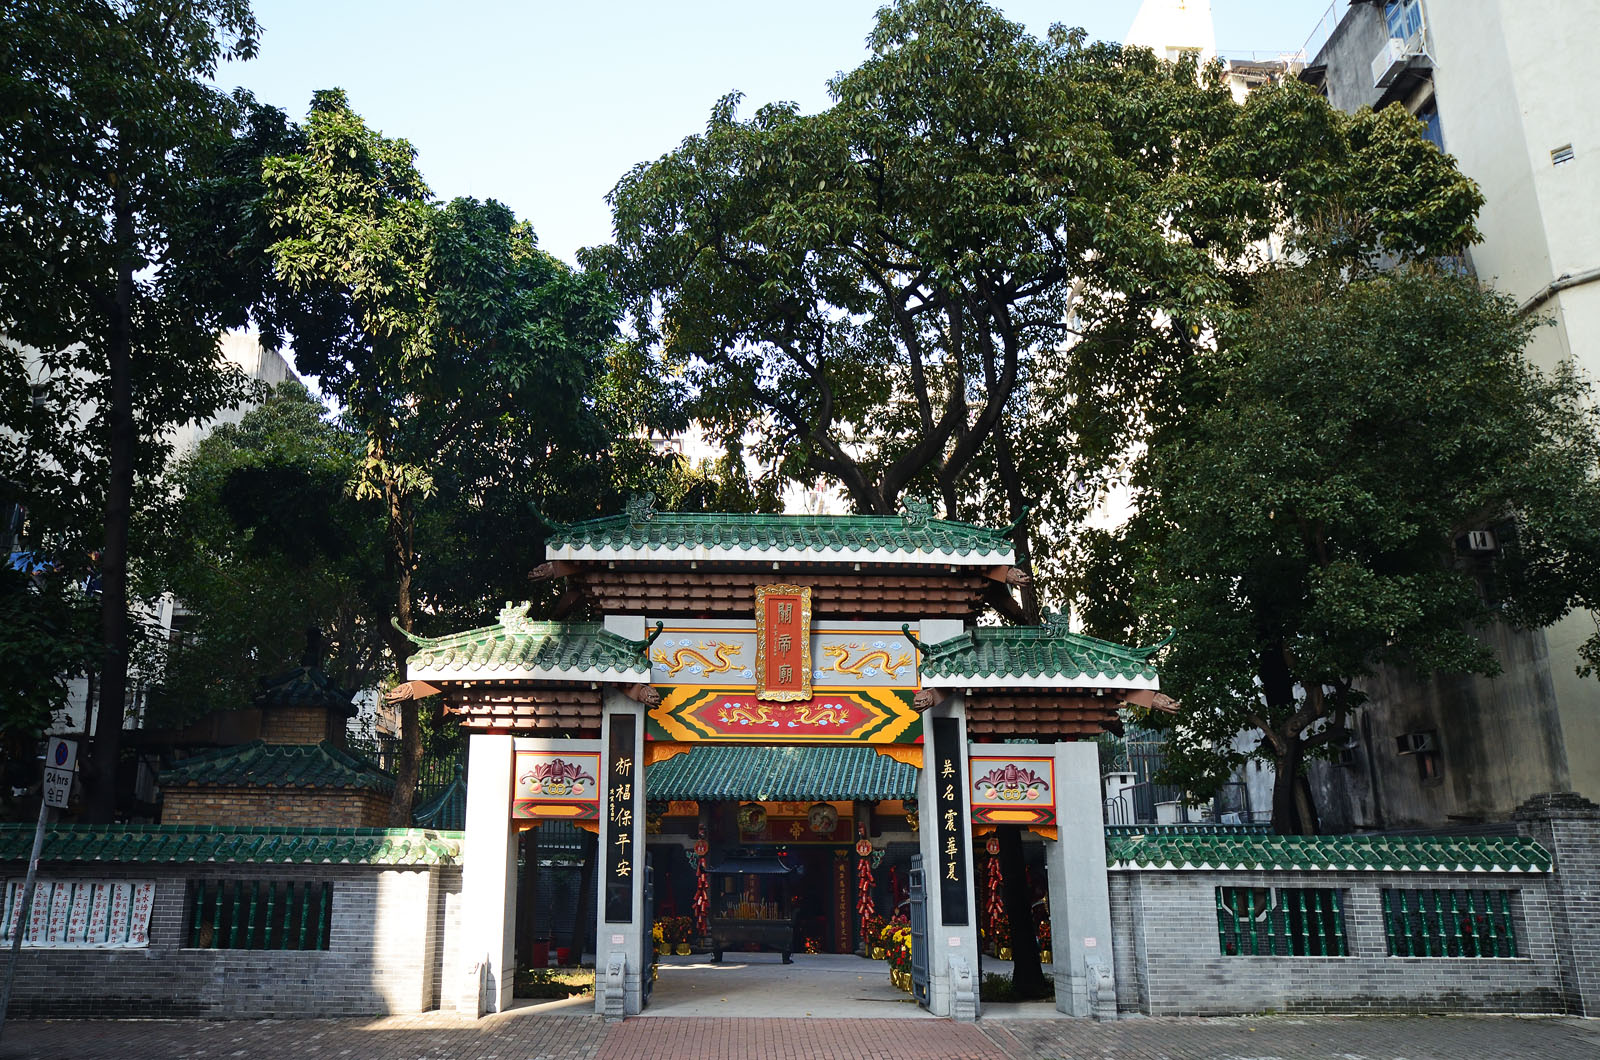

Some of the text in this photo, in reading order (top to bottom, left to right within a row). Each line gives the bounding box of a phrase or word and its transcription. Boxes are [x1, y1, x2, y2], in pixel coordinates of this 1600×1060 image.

[778, 602, 793, 684] 關帝廟
[46, 772, 69, 786] 24 hrs
[47, 788, 64, 803] 全日
[615, 757, 633, 877] 祈福保平安
[941, 759, 959, 881] 英名震華夏
